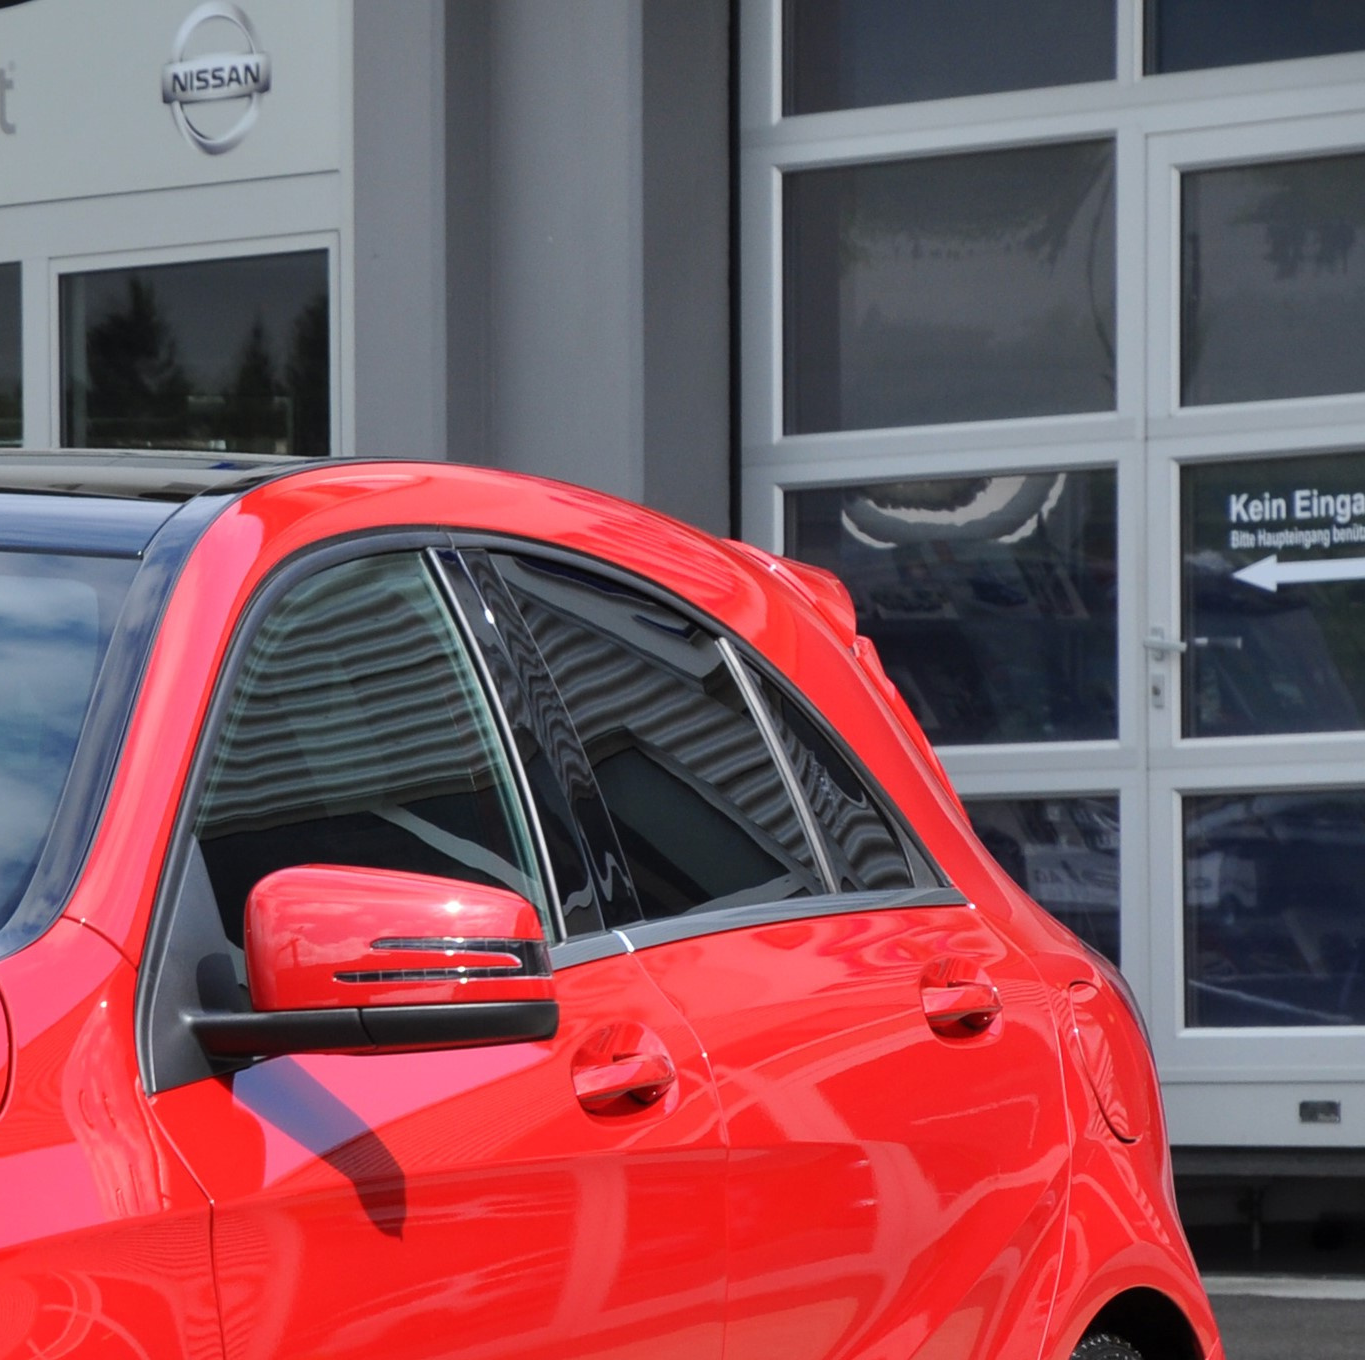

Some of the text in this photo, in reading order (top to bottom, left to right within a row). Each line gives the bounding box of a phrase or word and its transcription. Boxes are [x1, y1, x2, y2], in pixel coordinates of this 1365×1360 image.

[172, 62, 260, 93] NISSAN
[1230, 489, 1365, 524] Kein Einga
[1230, 530, 1256, 549] Bitte
[1257, 527, 1330, 549] Haupteingang
